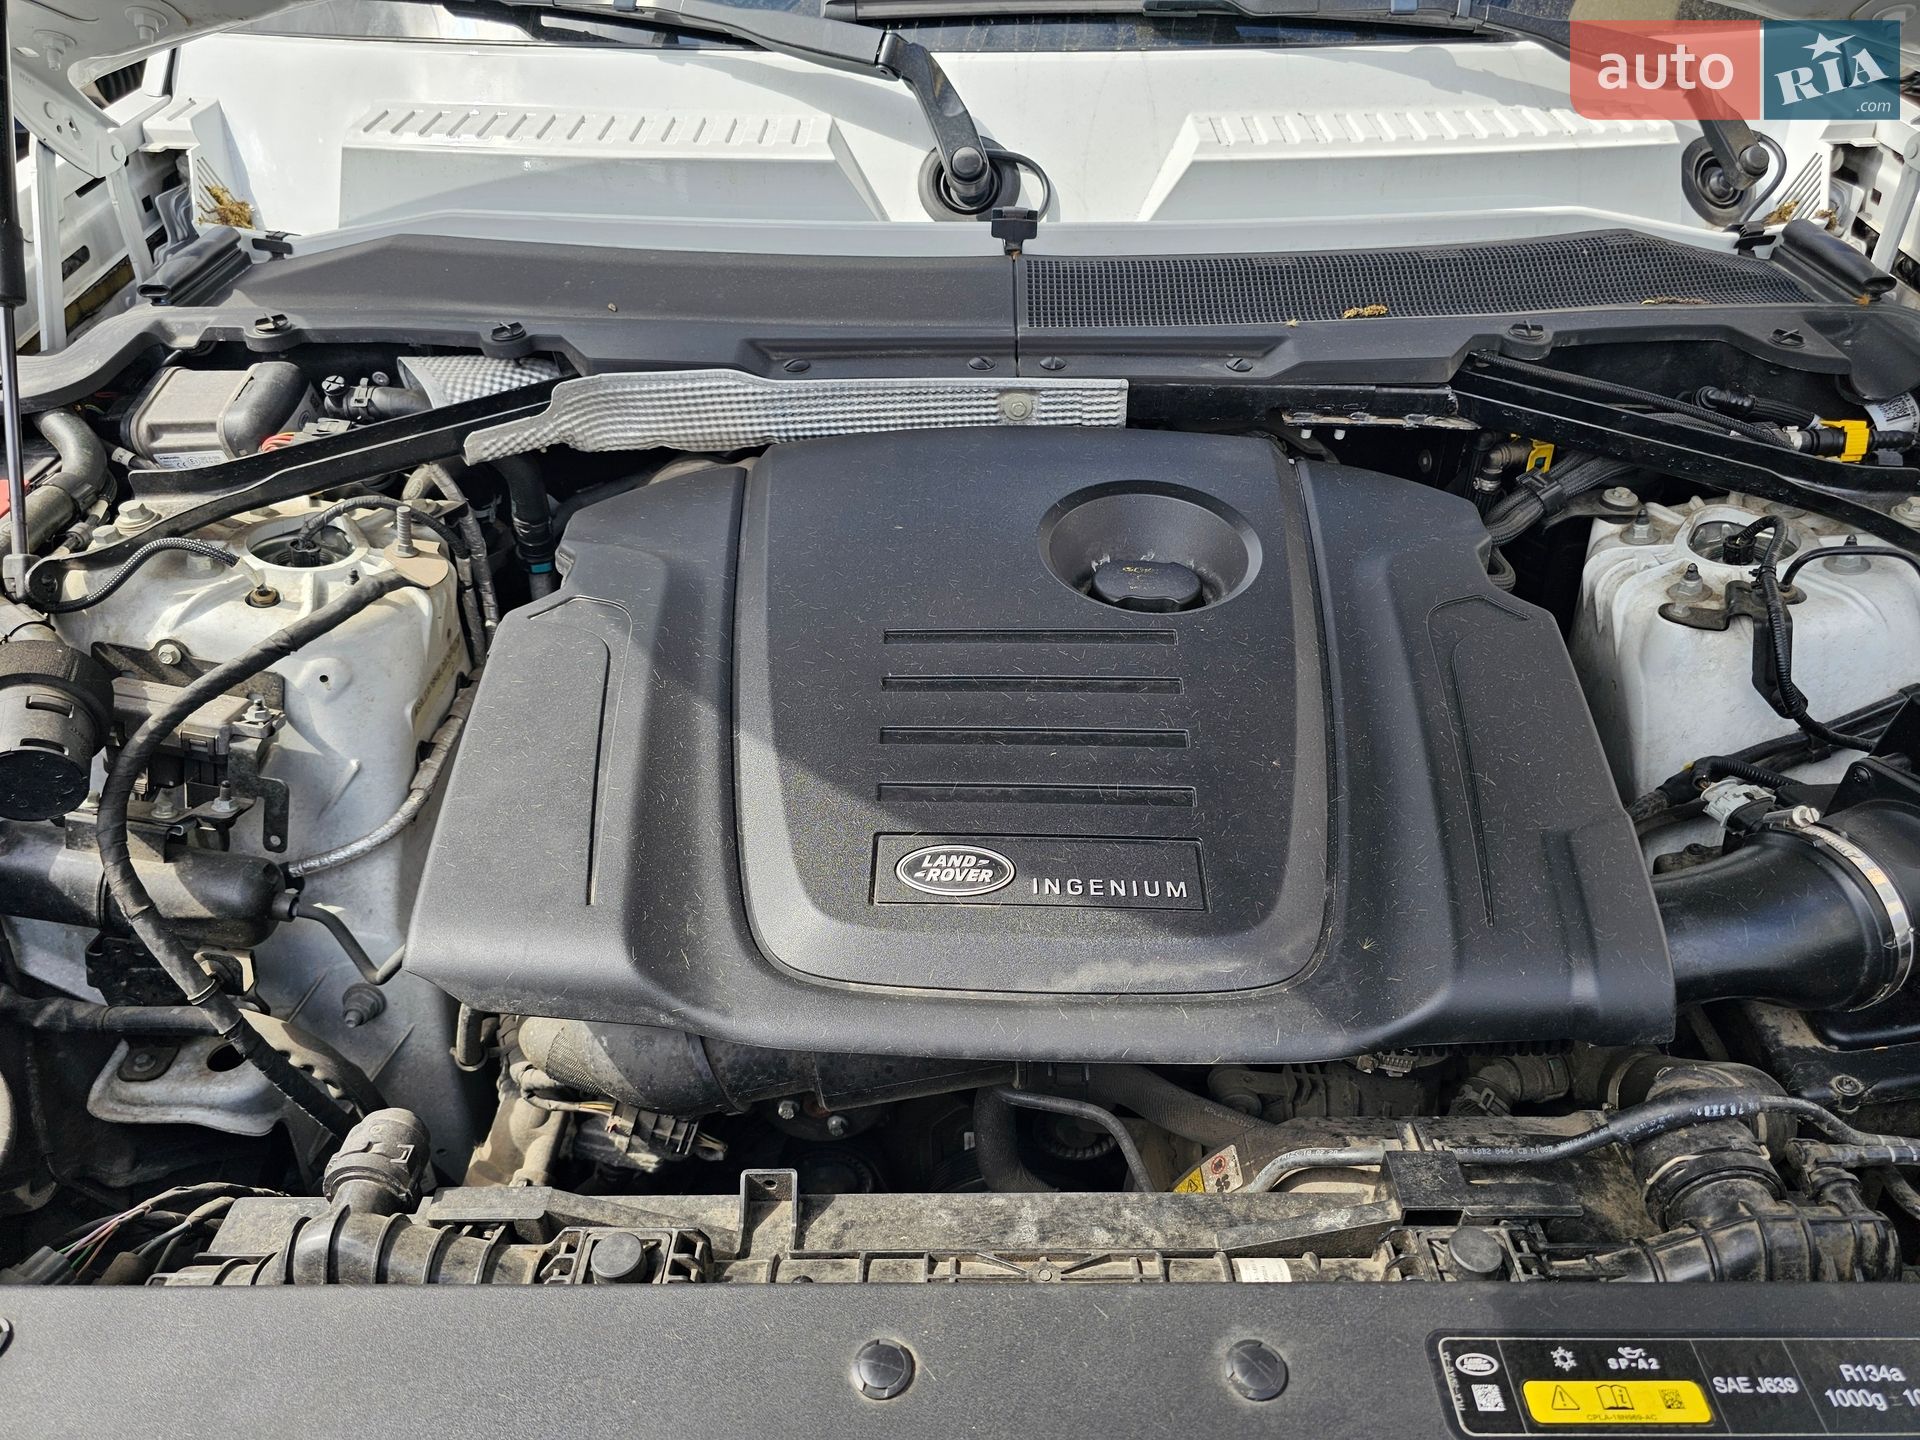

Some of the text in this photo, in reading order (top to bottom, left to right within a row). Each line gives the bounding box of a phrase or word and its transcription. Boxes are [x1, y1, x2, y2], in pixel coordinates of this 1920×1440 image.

[921, 854, 977, 868] LAND
[925, 868, 994, 883] ROVER
[1032, 877, 1188, 898] INGENIUM
[1607, 1357, 1661, 1370] SP-A2
[1839, 1364, 1906, 1382] R134a
[1712, 1376, 1800, 1394] SAE J639
[1824, 1388, 1889, 1412] 1000g
